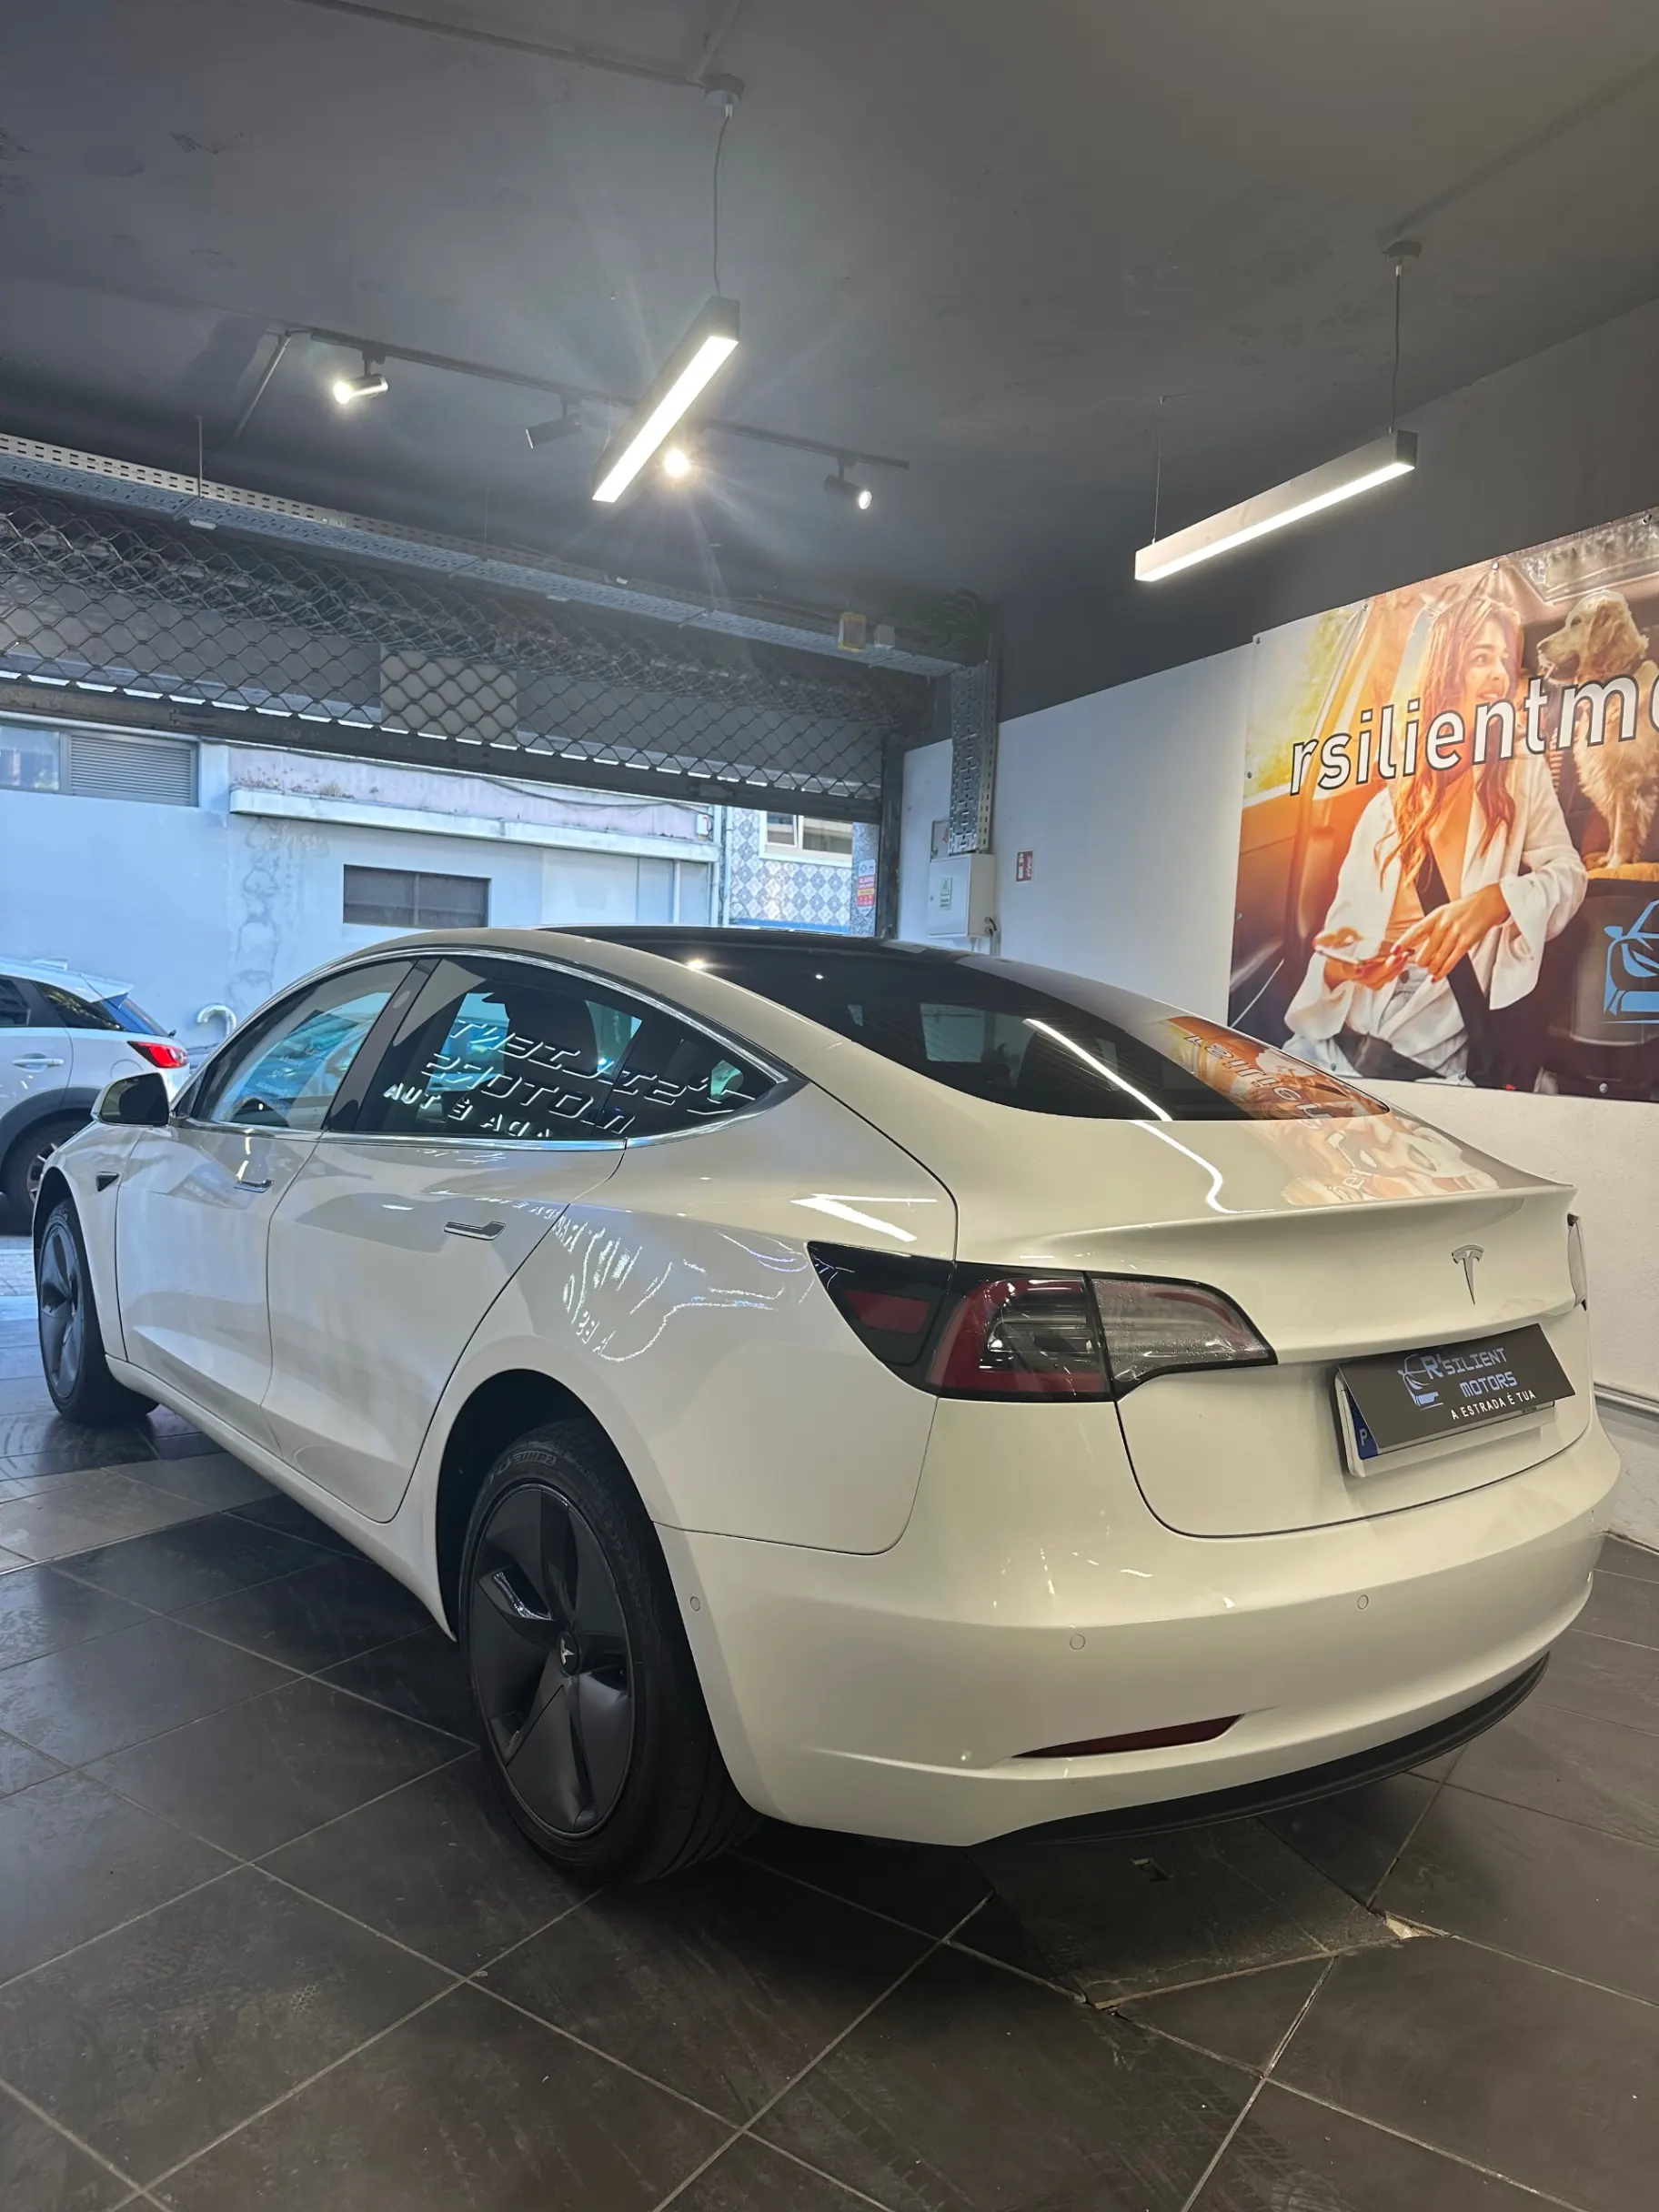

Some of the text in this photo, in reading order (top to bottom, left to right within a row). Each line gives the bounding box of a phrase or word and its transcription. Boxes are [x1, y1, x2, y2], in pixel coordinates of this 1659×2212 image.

[1289, 673, 1659, 797] rsilientm
[1459, 1371, 1518, 1398] MOTORS
[1451, 1409, 1459, 1420] A
[1462, 1397, 1506, 1418] ESTRADA
[1507, 1392, 1515, 1406] É
[1518, 1389, 1536, 1403] TUA
[1358, 1428, 1368, 1447] P
